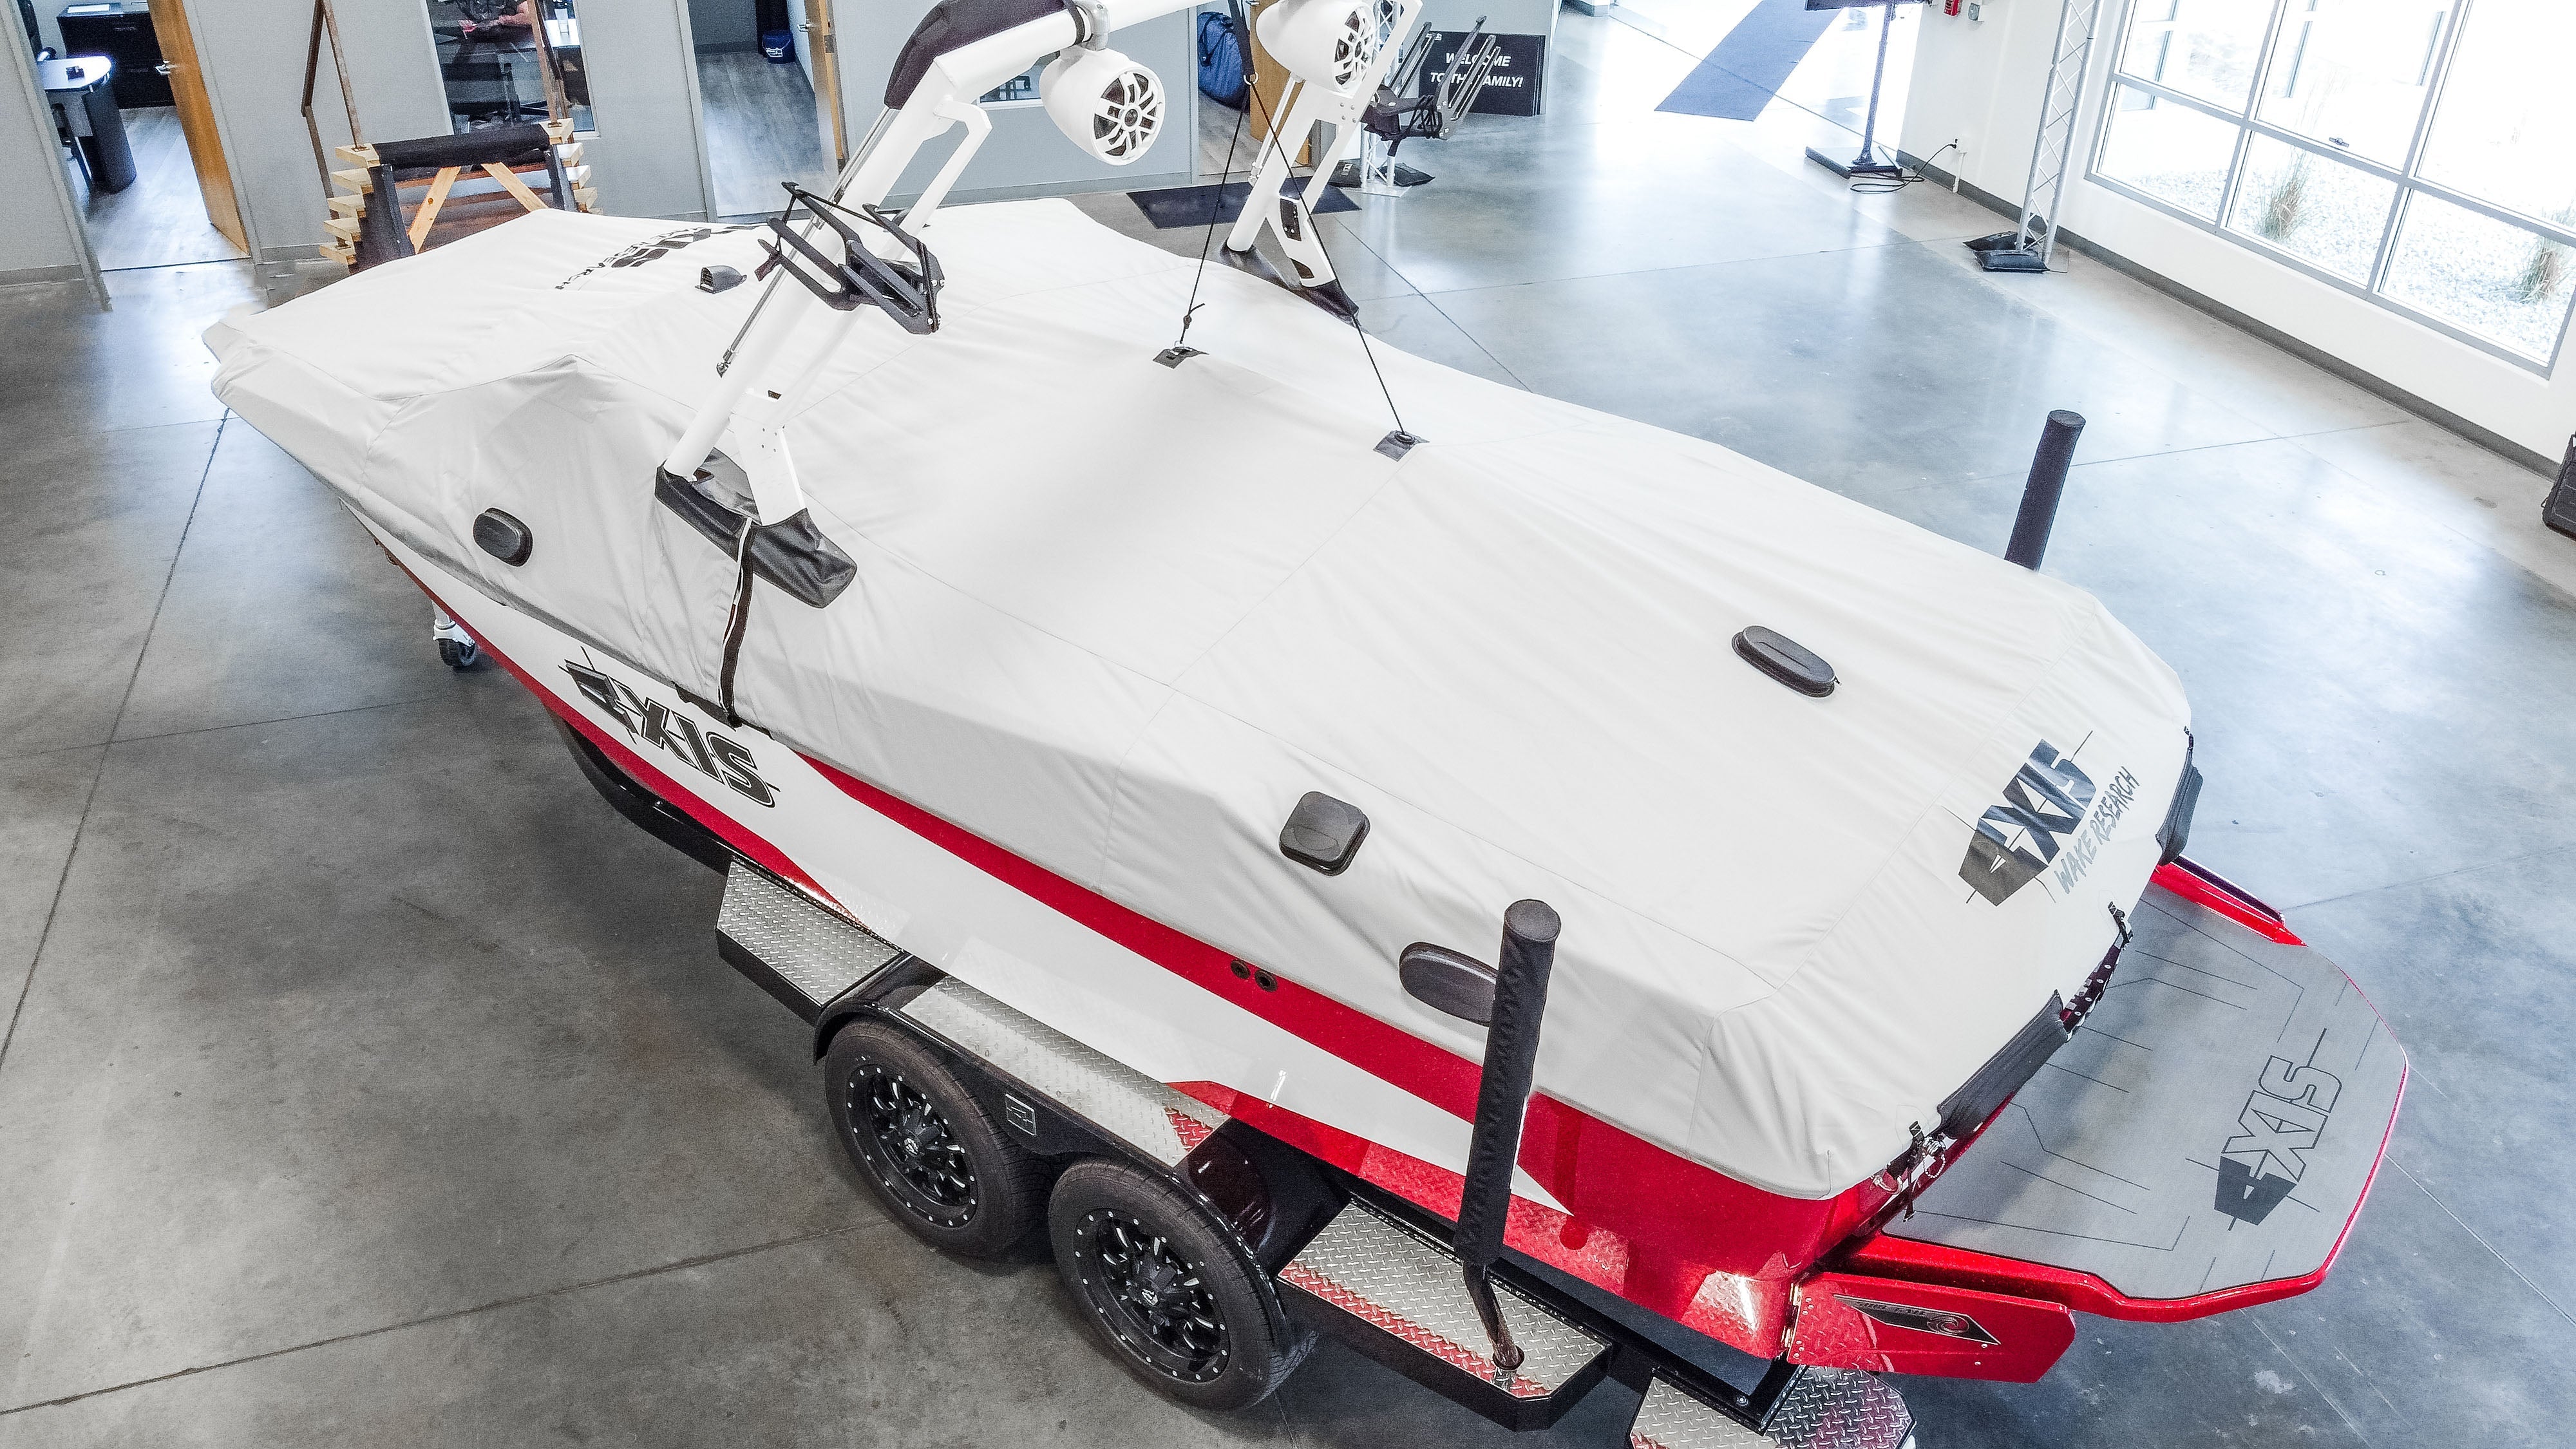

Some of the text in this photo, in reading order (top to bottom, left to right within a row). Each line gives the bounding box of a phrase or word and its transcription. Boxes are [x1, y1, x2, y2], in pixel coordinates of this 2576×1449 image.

[1430, 72, 1524, 88] TO TH AMILY!
[1446, 52, 1511, 67] WELCOME
[562, 659, 777, 808] AXIS
[1958, 738, 2097, 907] AXIS
[2054, 766, 2141, 895] WAKE RESEARCH
[2213, 1054, 2343, 1226] AXIS
